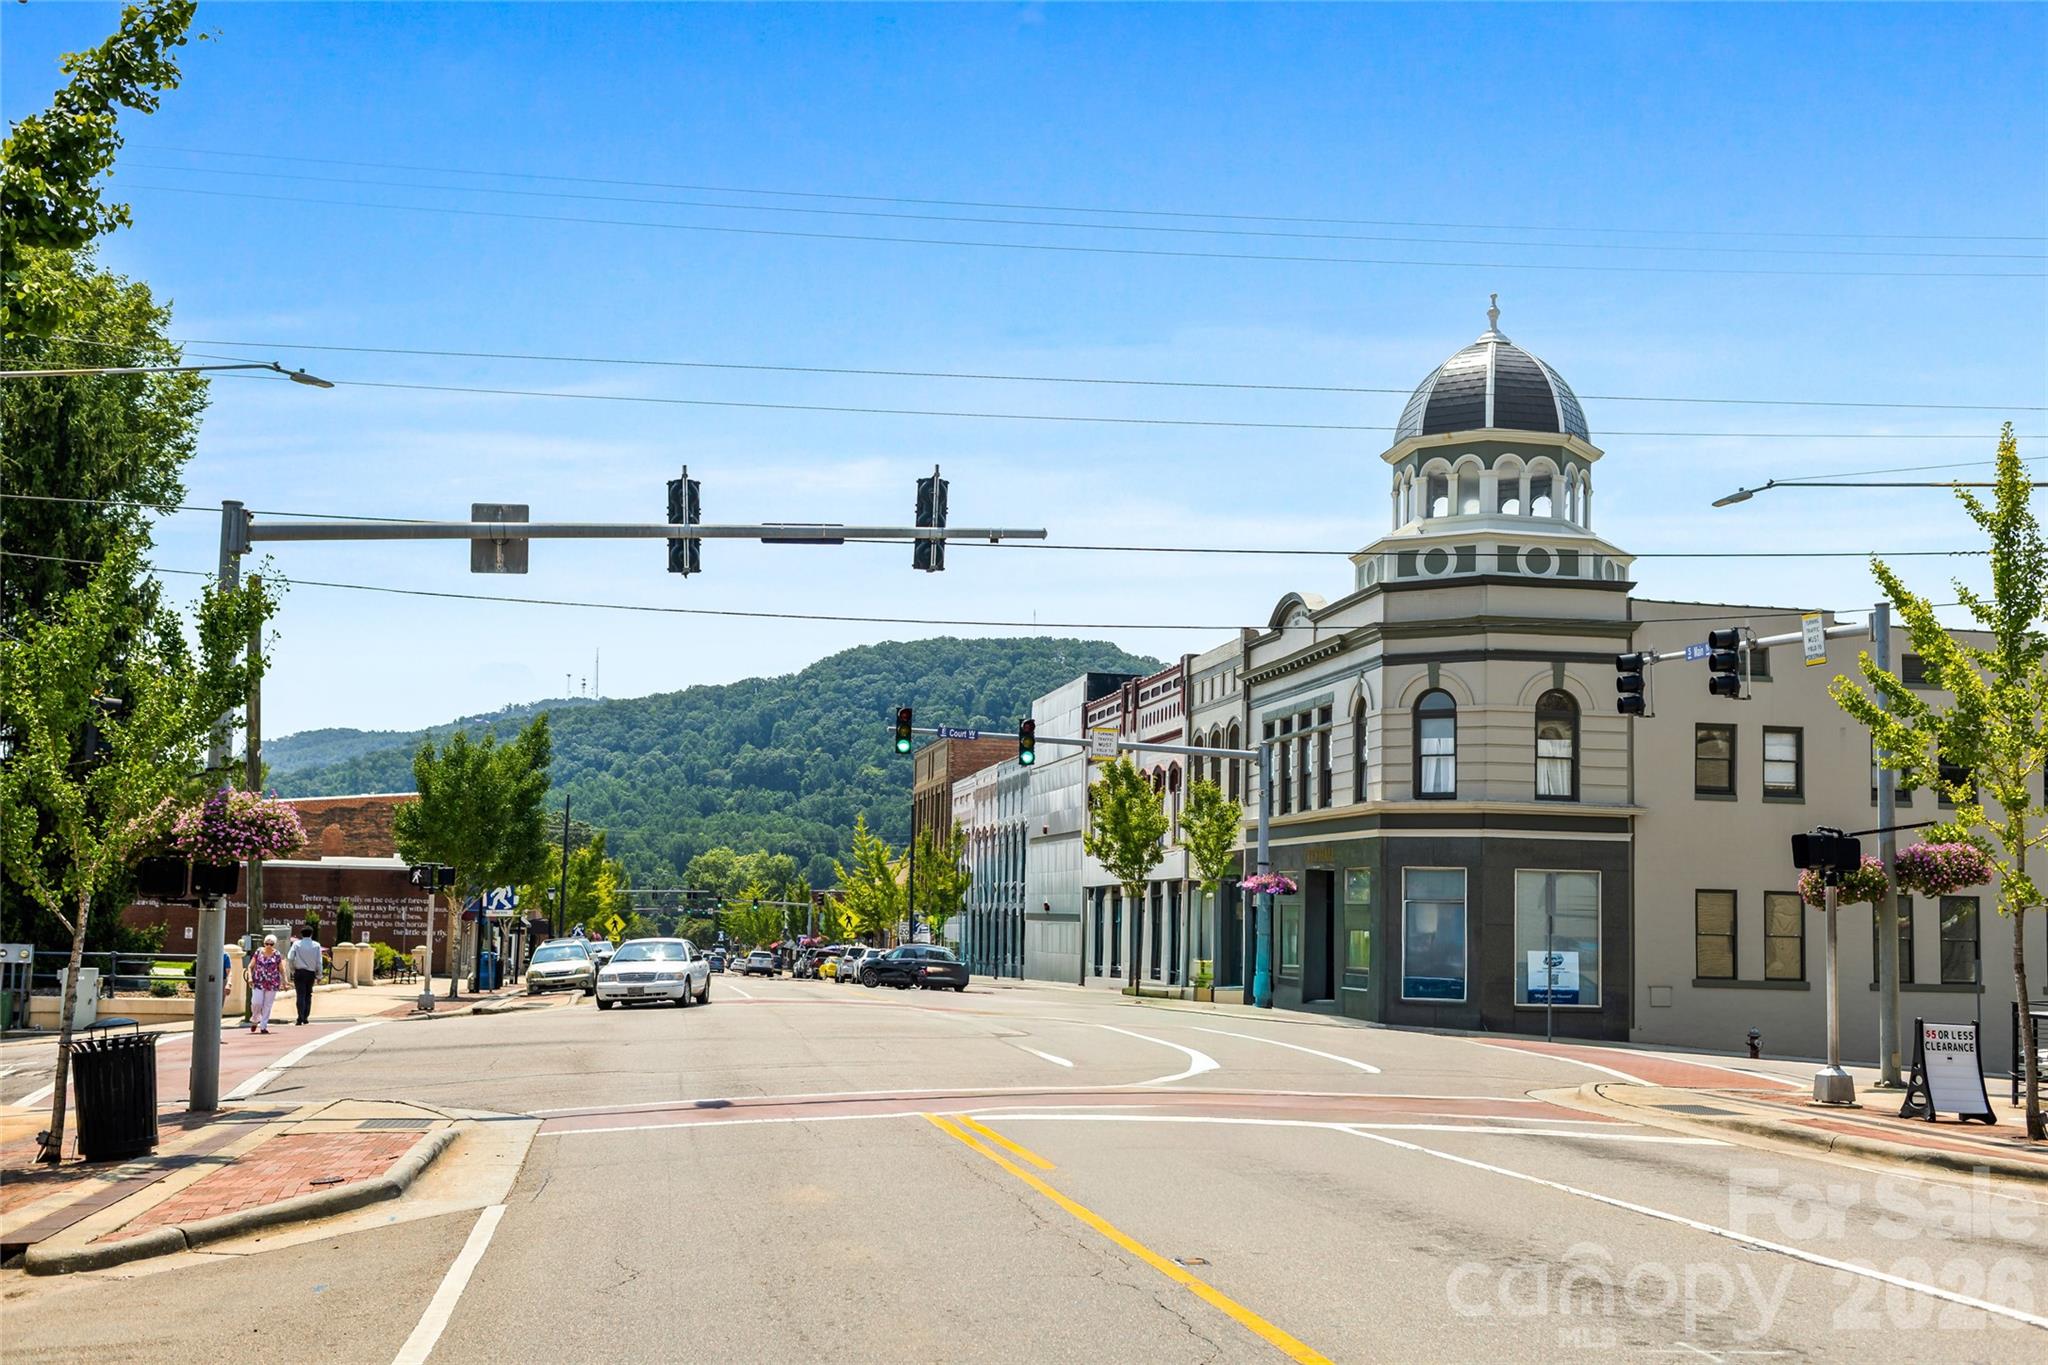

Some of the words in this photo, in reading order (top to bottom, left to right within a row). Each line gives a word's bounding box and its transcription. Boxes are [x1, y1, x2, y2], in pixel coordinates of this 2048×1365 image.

[950, 729, 967, 738] Court
[1938, 1030, 1949, 1040] OR
[1951, 1031, 1974, 1040] LESS
[1925, 1041, 1974, 1052] CLEARANCE
